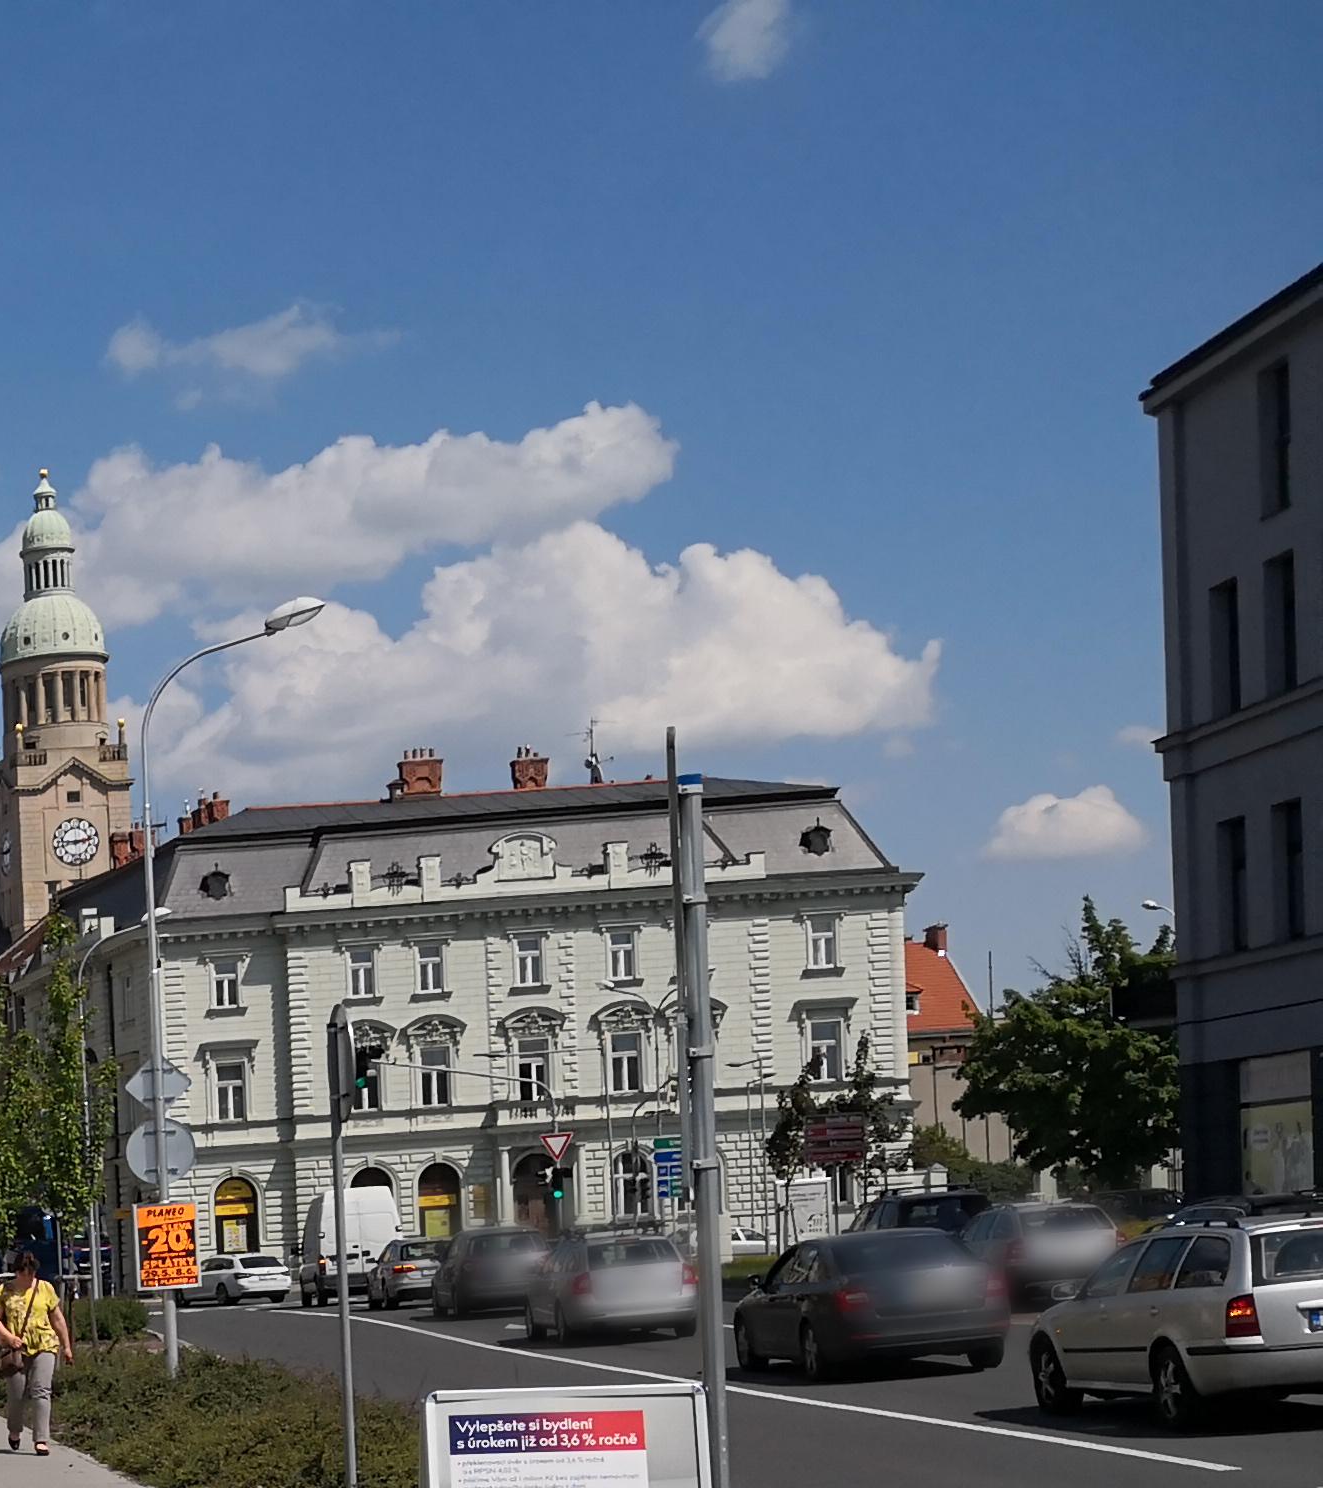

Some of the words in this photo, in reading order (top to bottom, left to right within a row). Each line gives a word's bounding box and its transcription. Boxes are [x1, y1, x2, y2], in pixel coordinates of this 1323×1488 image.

[147, 1207, 185, 1217] PLANEO
[455, 1419, 529, 1436] Vylepšete
[530, 1418, 540, 1431] si
[542, 1417, 594, 1434] bydlení
[457, 1440, 465, 1449] s
[468, 1435, 519, 1449] úrokem
[521, 1434, 537, 1450] již
[539, 1434, 558, 1447] od
[560, 1433, 580, 1447] 3,6
[583, 1433, 597, 1446] %
[598, 1432, 637, 1446] ročně
